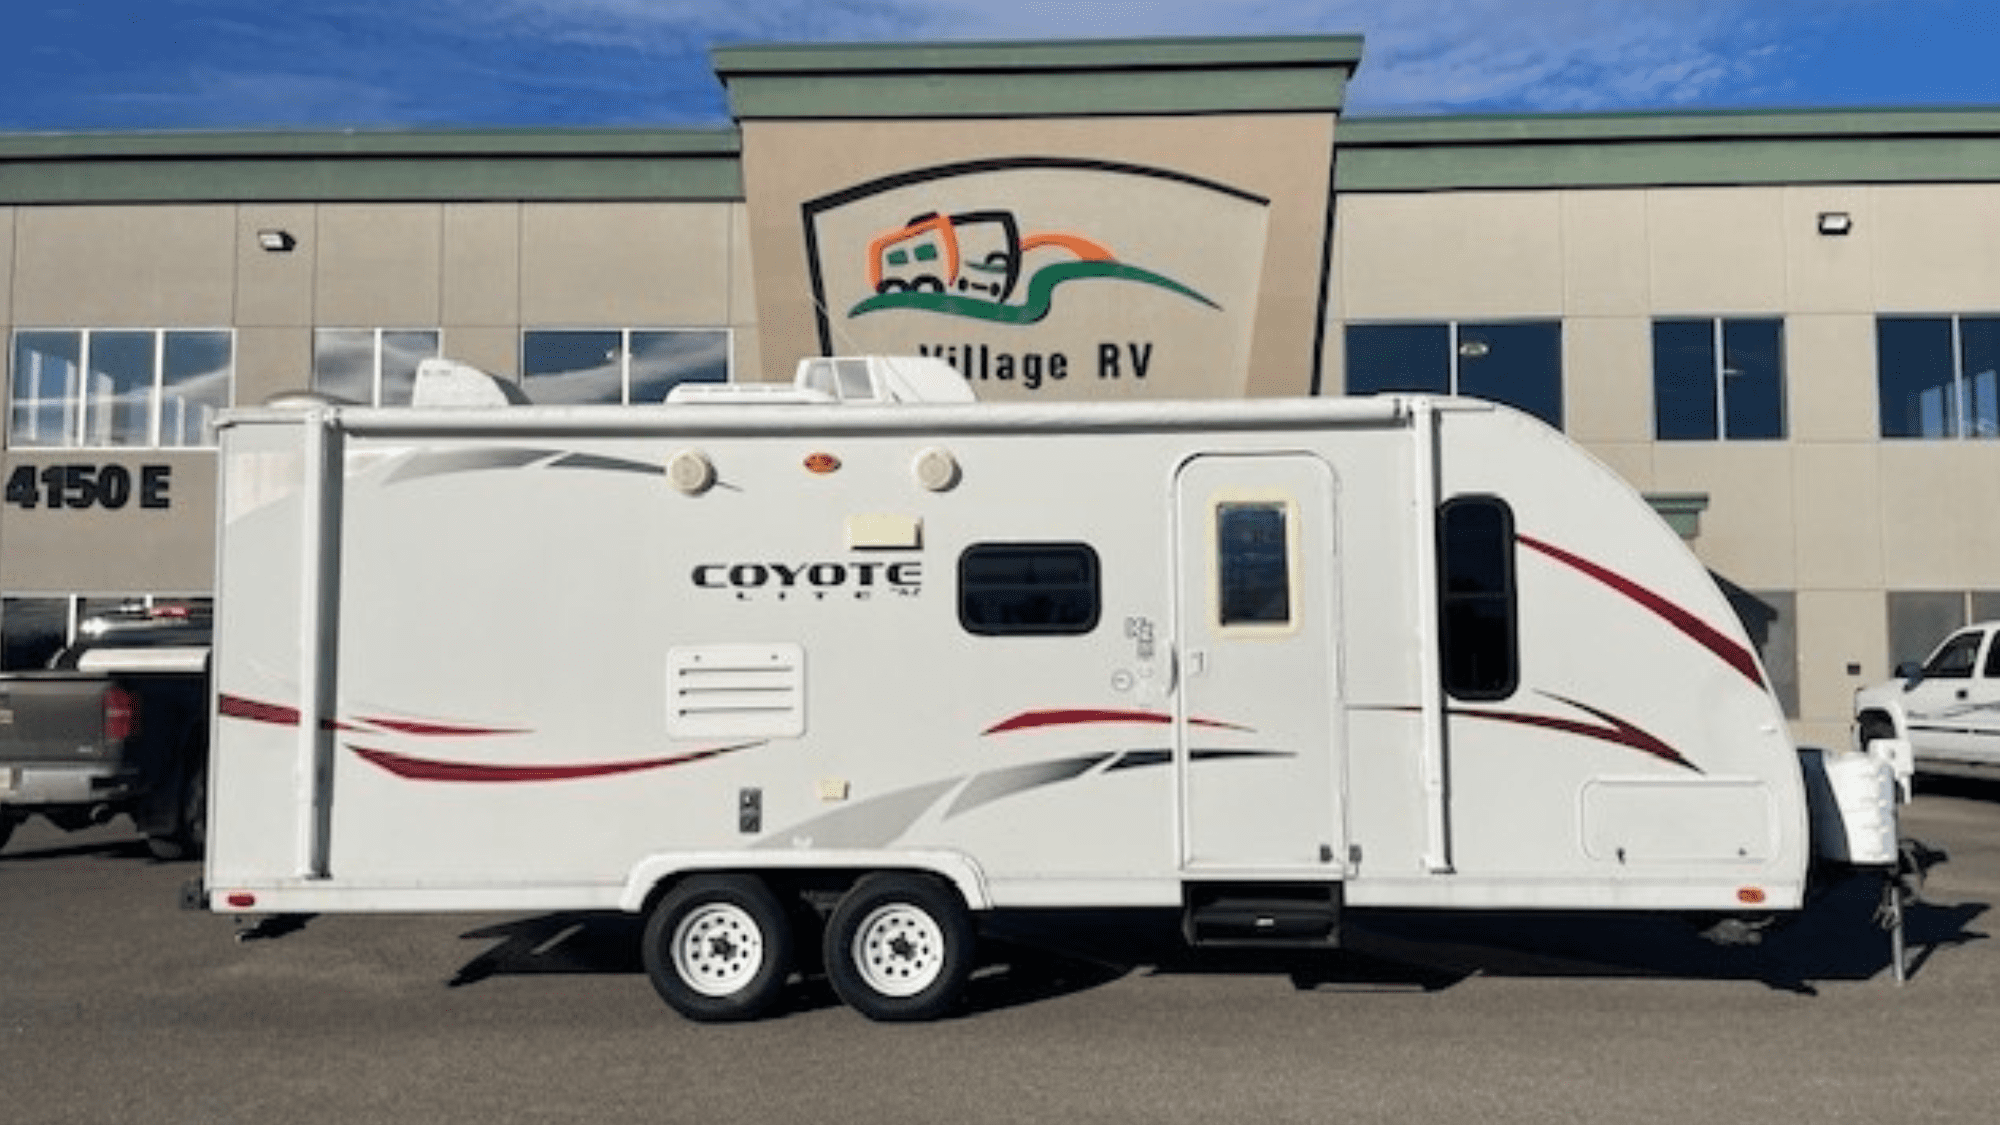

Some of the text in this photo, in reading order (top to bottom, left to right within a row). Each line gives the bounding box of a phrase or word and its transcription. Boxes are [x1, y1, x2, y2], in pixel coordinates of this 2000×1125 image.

[1098, 343, 1153, 379] RV
[6, 464, 171, 509] 4150 E
[691, 561, 922, 588] COYOTE
